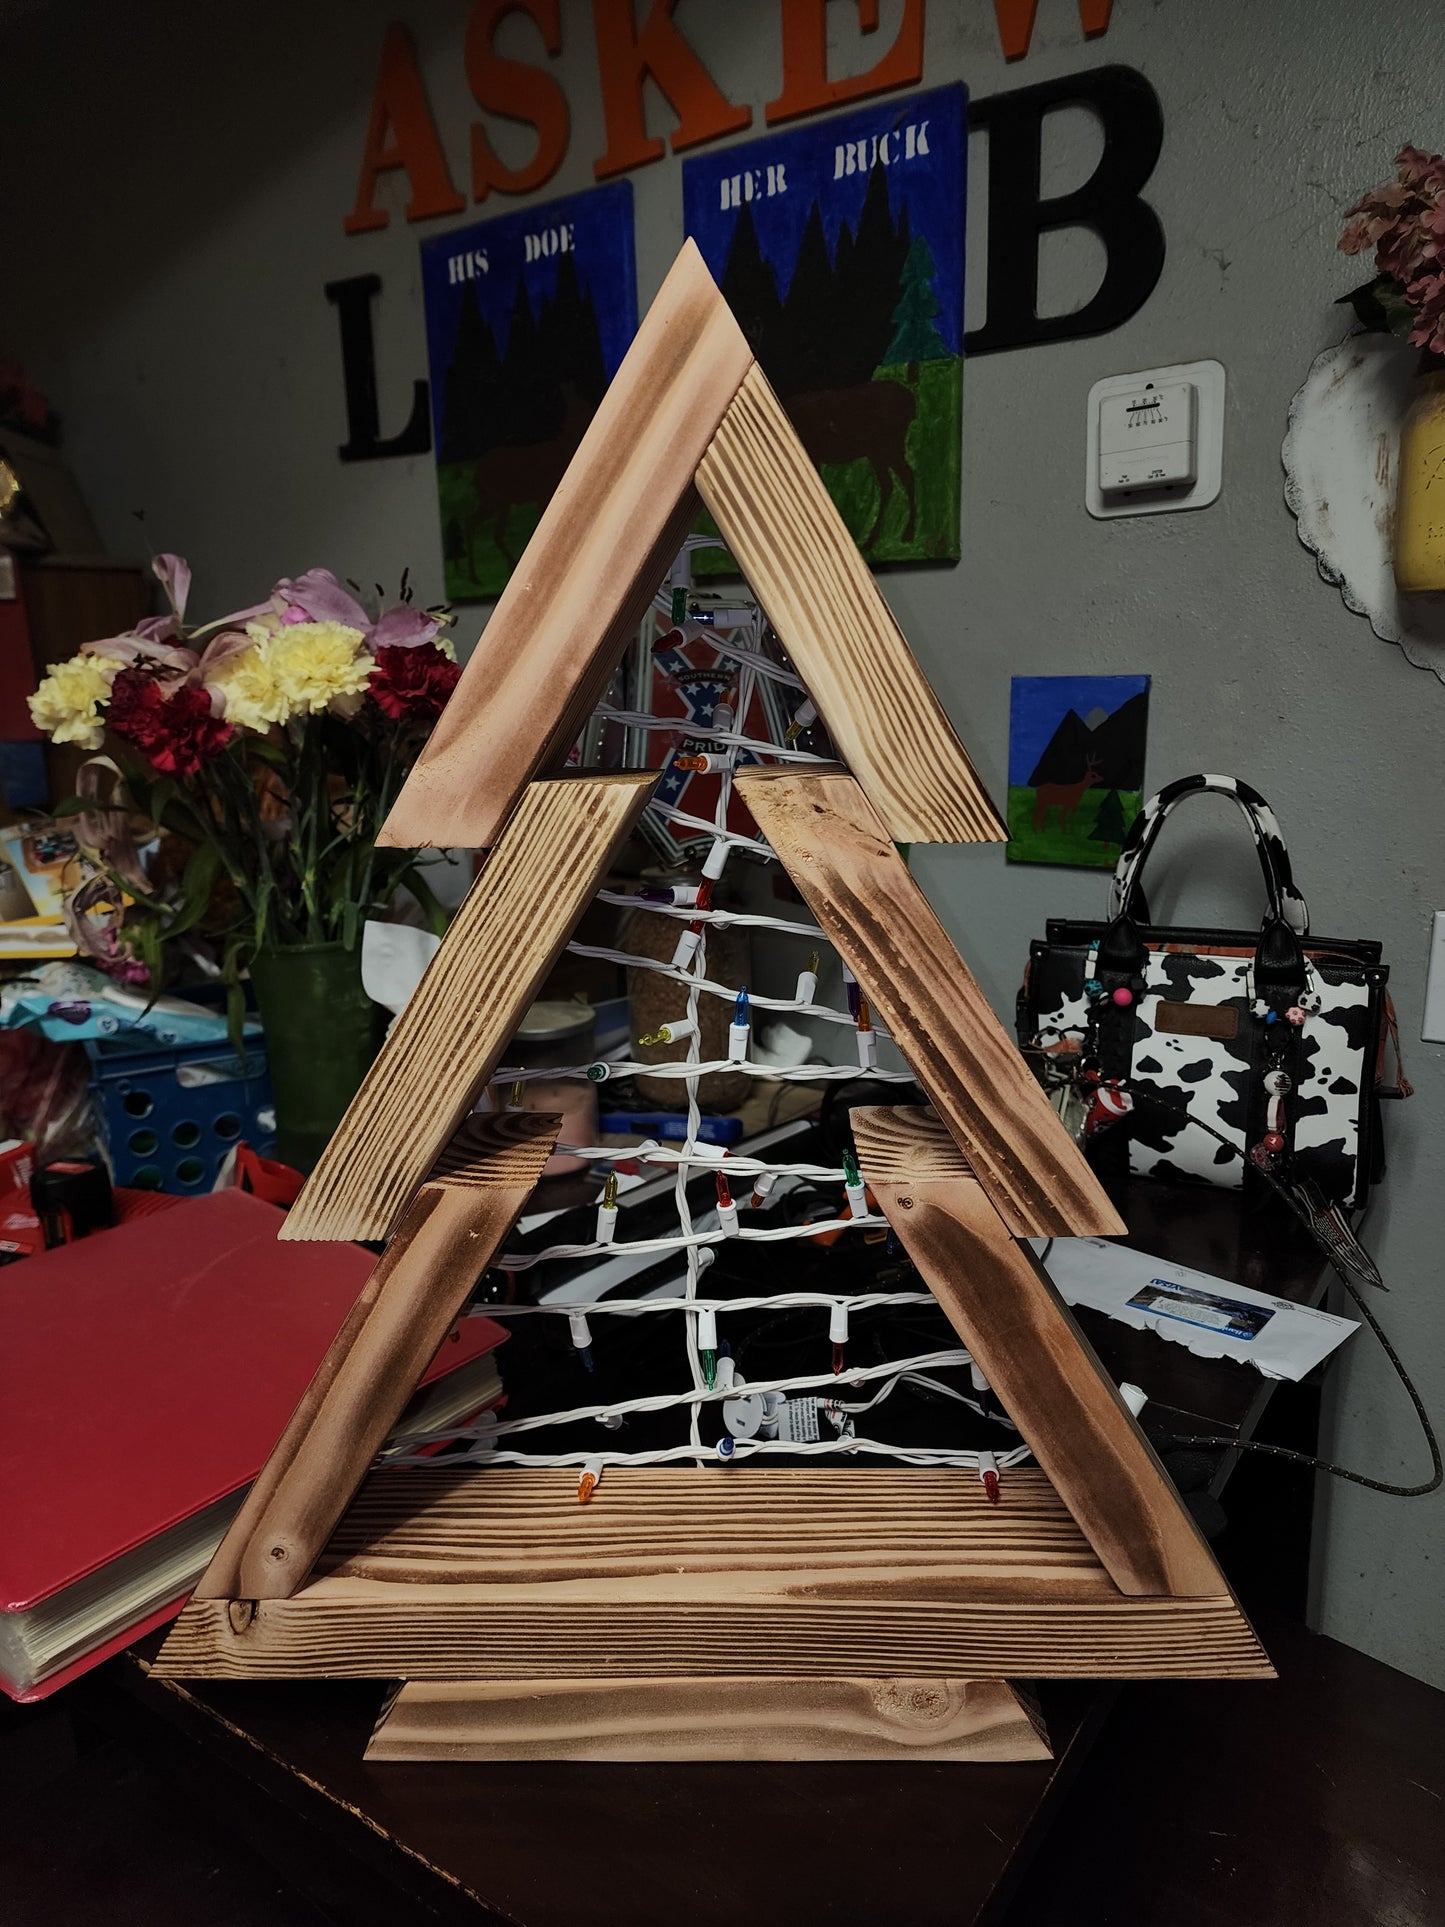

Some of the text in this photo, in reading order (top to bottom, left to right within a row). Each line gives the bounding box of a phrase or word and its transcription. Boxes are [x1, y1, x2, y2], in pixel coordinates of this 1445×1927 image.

[343, 0, 1113, 236] ASKE
[719, 120, 930, 211] HER BUCK
[963, 63, 1166, 358] B
[448, 223, 575, 285] HIS DOE
[324, 273, 432, 462] L
[678, 671, 731, 682] SOUTHERN
[682, 738, 728, 753] PRID
